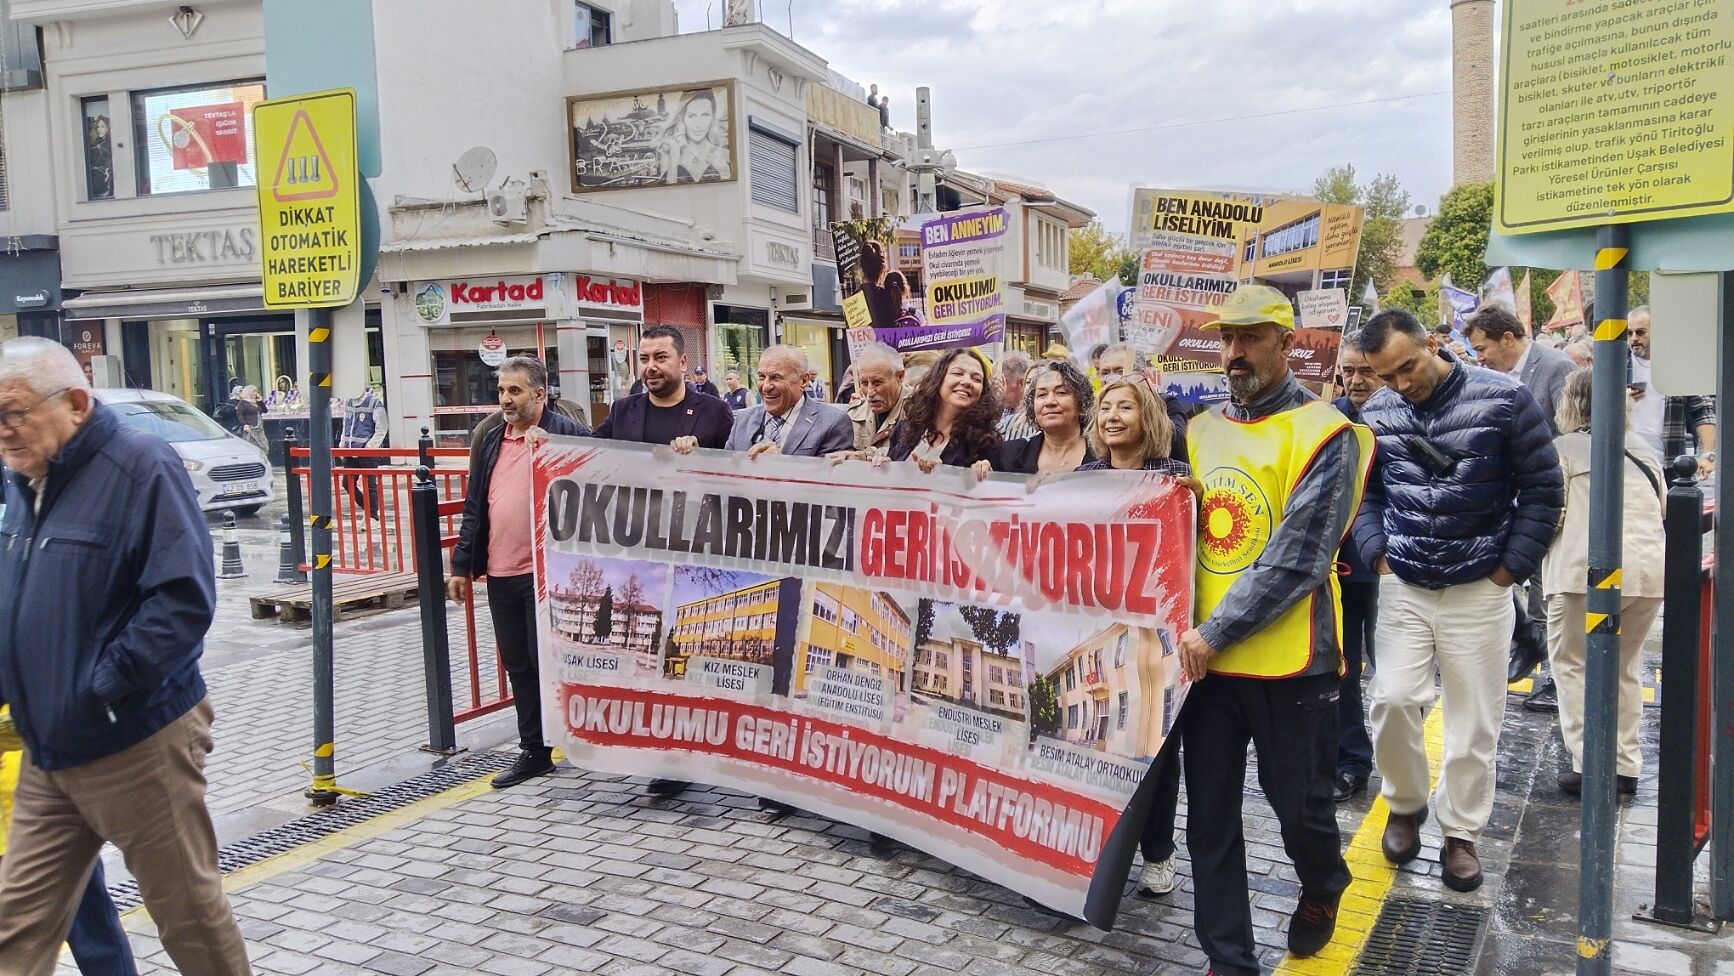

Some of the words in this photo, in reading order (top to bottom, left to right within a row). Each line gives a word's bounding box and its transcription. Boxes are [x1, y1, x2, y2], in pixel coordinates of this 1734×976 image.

[1520, 14, 1558, 31] saatleri
[1561, 3, 1609, 22] arasında
[1530, 34, 1541, 43] ve
[1544, 23, 1592, 39] bindirme
[1595, 11, 1643, 31] yapacak
[1646, 1, 1690, 18] araçlar
[1527, 44, 1562, 58] trafiğe
[1565, 31, 1628, 50] açılmasına,
[1631, 21, 1669, 36] bunun
[1672, 10, 1718, 28] dışında
[1531, 56, 1565, 72] hususi
[1567, 49, 1608, 65] amaçla
[1610, 33, 1682, 55] kullanılacak
[1686, 28, 1711, 40] tüm
[1514, 74, 1556, 90] araçlara
[1559, 64, 1606, 81] (bisiklet,
[1610, 50, 1677, 70] motosiklet,
[1681, 40, 1732, 57] motorlu
[1518, 89, 1558, 103] bisiklet,
[1562, 81, 1597, 95] skuter
[1600, 78, 1613, 87] ve
[1616, 68, 1665, 85] bunların
[1668, 55, 1725, 76] elektrikli
[1539, 99, 1578, 113] olanları
[1581, 95, 1593, 106] ile
[1643, 77, 1697, 95] triportör
[1522, 121, 1545, 131] tarzı
[1547, 111, 1595, 127] araçların
[1598, 101, 1660, 118] tamamının
[1663, 92, 1717, 107] caddeye
[1523, 128, 1579, 147] girişlerinin
[1582, 114, 1676, 138] yasaklanmasına
[1680, 108, 1712, 120] karar
[1522, 146, 1562, 160] verilmiş
[1565, 143, 1592, 153] olup,
[1595, 135, 1626, 149] trafik
[1629, 130, 1658, 146] yönü
[1661, 123, 1714, 139] Tiritoğlu
[1513, 164, 1539, 175] Parkı
[1541, 153, 1624, 171] istikametinden
[1627, 147, 1656, 160] Uşak
[1660, 137, 1725, 155] Belediyesi
[1549, 171, 1588, 184] Yöresel
[1591, 166, 1634, 179] Ürünler
[1637, 161, 1679, 175] Çarşısı
[1536, 185, 1603, 201] istikametine
[1606, 182, 1625, 192] tek
[1628, 179, 1650, 192] yön
[1653, 174, 1692, 187] olarak
[1156, 197, 1188, 215] BEN
[1190, 199, 1263, 223] ANADOLU
[1566, 193, 1655, 212] düzenlenmiştir.
[279, 206, 335, 227] DİKKAT
[925, 223, 949, 245] BEN
[951, 212, 1006, 240] ANNEYİM.
[1153, 214, 1236, 239] LİSELİYİM.
[150, 227, 256, 264] TEKTAŞ
[270, 227, 348, 251] OTOMATİK
[268, 251, 352, 275] HAREKETLİ
[278, 277, 342, 298] BARİYER
[450, 277, 544, 304] Kartad
[575, 275, 641, 307] Kartad
[934, 277, 997, 303] OKULUMU
[1142, 285, 1172, 300] GERİ
[1143, 272, 1238, 294] OKULLARIMIZI
[933, 301, 956, 319] GERİ
[957, 292, 1004, 316] İSTİYORUM.
[1163, 361, 1180, 372] GERİ
[548, 478, 856, 572] OKULLARIMIZI
[860, 502, 937, 583] GERİ
[586, 655, 619, 671] LİSESİ
[703, 661, 720, 674] KIZ
[722, 663, 760, 680] MESLEK
[716, 676, 745, 691] LİSESİ
[826, 669, 853, 685] ORHAN
[855, 676, 883, 691] DENGİZ
[821, 683, 858, 701] ANADOLU
[860, 690, 883, 707] LİSESİ
[956, 728, 980, 746] LİSESİ
[972, 715, 1002, 733] MESLEK
[1040, 743, 1064, 764] BESİM
[1065, 751, 1096, 771] ATALAY
[568, 694, 729, 746] OKULUMU
[735, 718, 798, 762] GERİ
[799, 721, 937, 804] İSTİYORUM
[937, 767, 1105, 865] PLATFORMU
